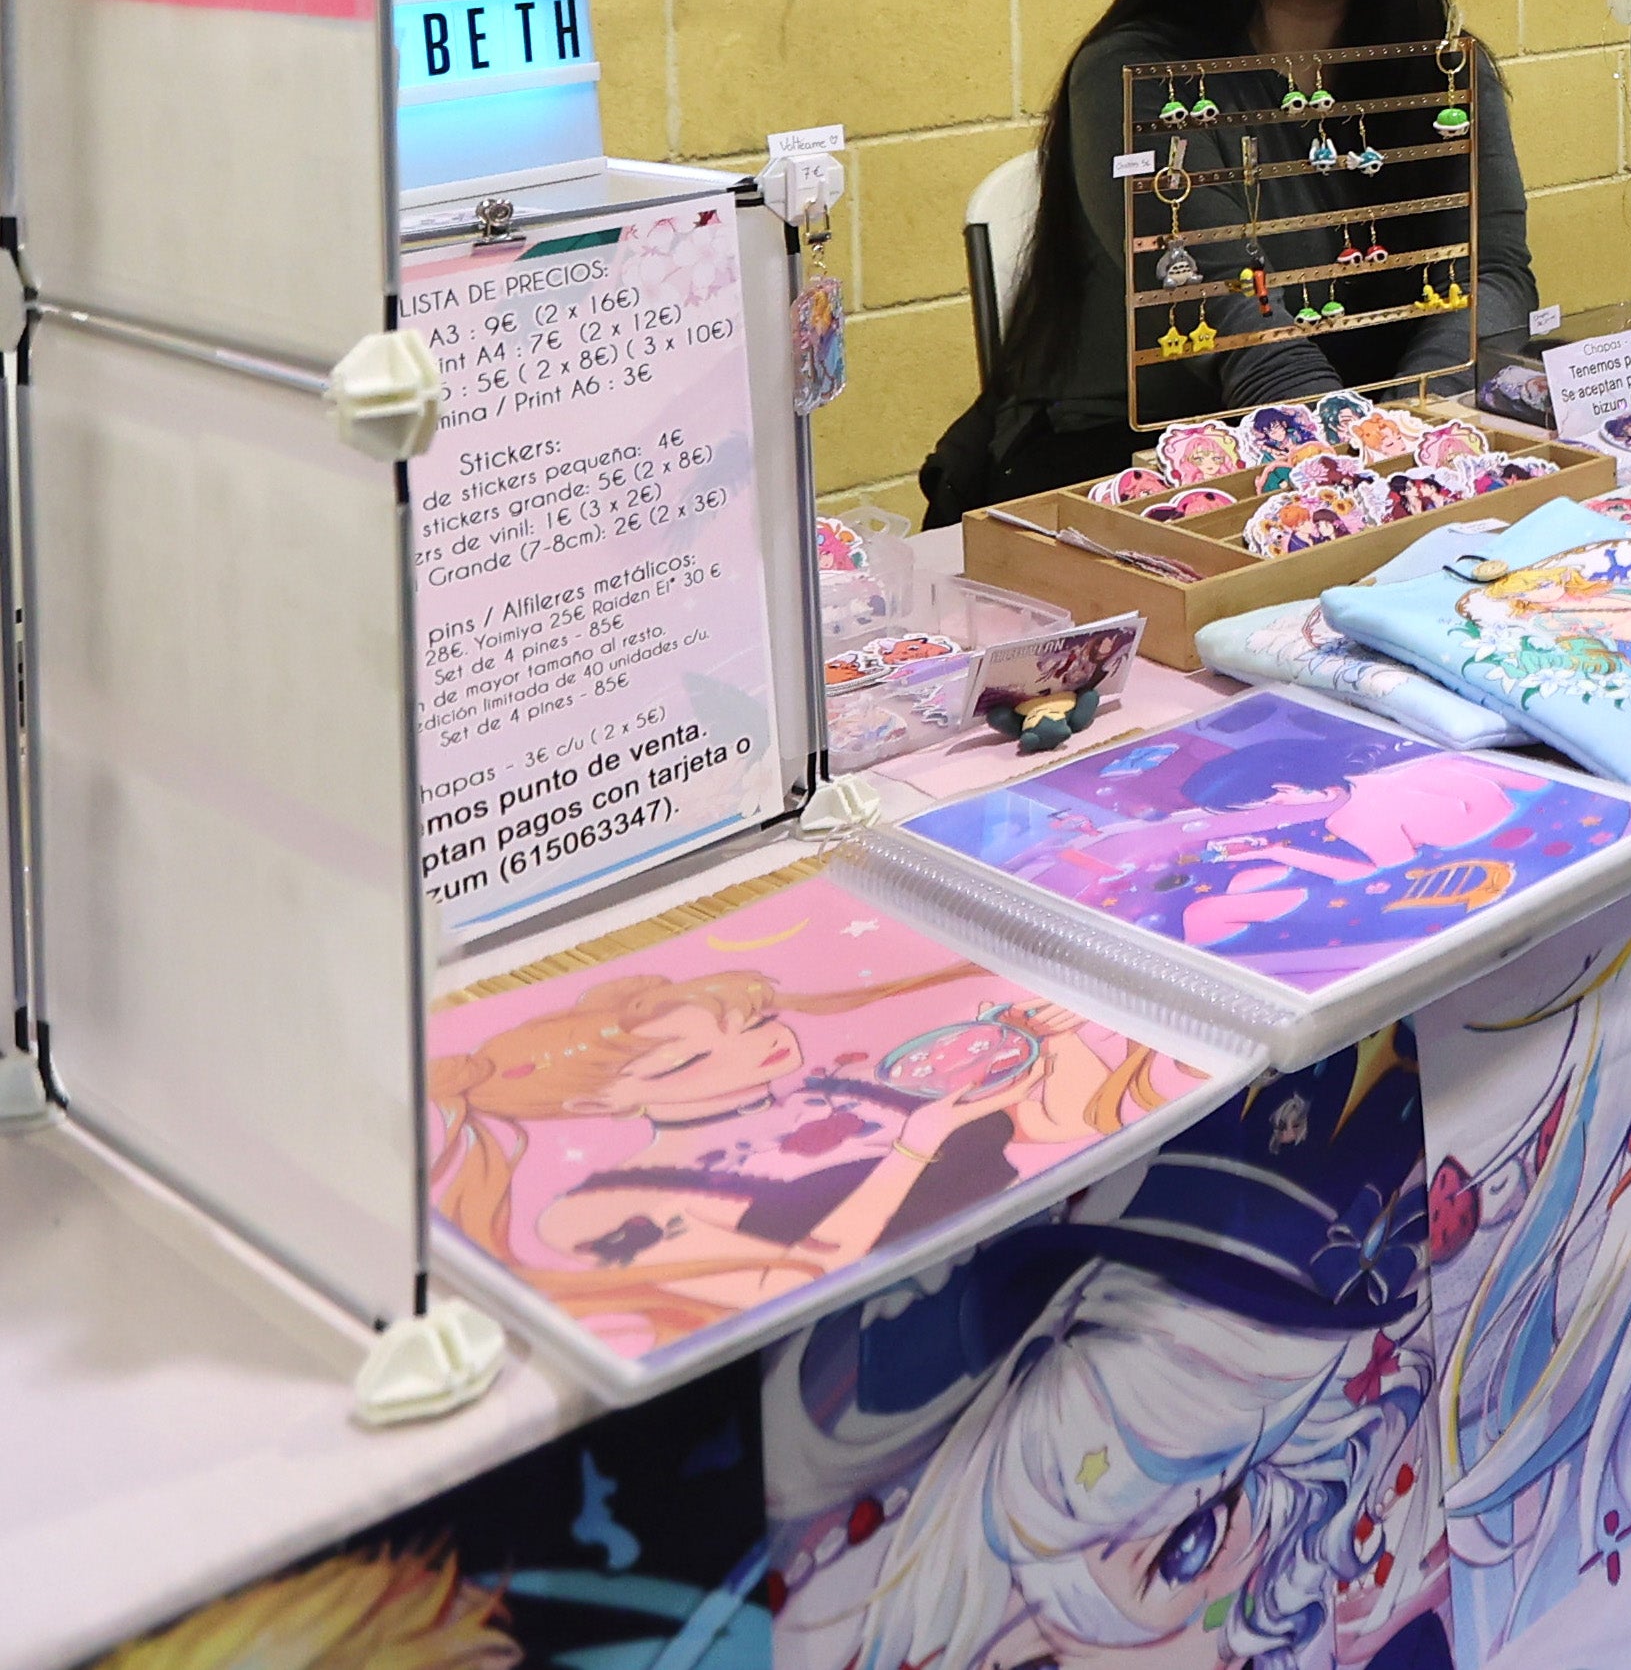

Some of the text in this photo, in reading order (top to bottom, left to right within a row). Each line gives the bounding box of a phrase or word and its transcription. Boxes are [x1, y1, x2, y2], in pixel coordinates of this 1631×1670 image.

[400, 260, 609, 318] LISTA DE PRECIOS:
[429, 325, 459, 348] A3
[485, 313, 517, 336] 9€
[535, 304, 557, 326] (2
[568, 306, 577, 319] x
[592, 288, 640, 314] 16€)
[439, 353, 465, 374] int
[477, 343, 505, 366] A4
[530, 331, 561, 354] 7€
[580, 322, 602, 343] (2
[612, 324, 620, 336] x
[635, 304, 681, 331] 12€)
[477, 369, 509, 393] 5€
[537, 360, 550, 380] 2
[561, 361, 570, 374] x
[579, 345, 618, 370] 8€)
[644, 337, 656, 355] 3
[666, 338, 674, 351] x
[688, 319, 733, 345] 10€)
[1568, 356, 1621, 380] Tenemos
[1583, 341, 1621, 356] Chapas
[497, 397, 505, 417] /
[515, 387, 561, 412] Print
[572, 377, 599, 398] A6
[623, 363, 652, 386] 3€
[1561, 389, 1576, 403] Se
[1579, 377, 1623, 398] aceptan
[1592, 399, 1627, 416] bizum
[423, 429, 684, 511] de stickers pequeña: 4€
[423, 445, 712, 537] stickers grande: 5€ (2 x 8€)
[460, 440, 561, 476] Stickers:
[428, 552, 512, 586] Grande
[521, 524, 606, 562] (7-8cm):
[614, 513, 642, 536] 2€
[650, 505, 669, 526] (2
[678, 506, 686, 518] x
[694, 488, 726, 512] 3€)
[452, 535, 481, 555] de
[490, 519, 534, 544] vinil:
[548, 508, 572, 529] 1€
[580, 499, 600, 520] (3
[610, 501, 618, 512] x
[626, 483, 661, 508] 2€)
[425, 642, 468, 667] 28€.
[474, 622, 542, 650] Yoimiya
[550, 605, 586, 629] 25€
[593, 590, 650, 615] Raiden
[684, 569, 704, 587] 30
[710, 563, 721, 578] €
[429, 554, 696, 648] pins / Alfileres metálicos:
[434, 666, 462, 685] Set
[472, 658, 495, 673] de
[504, 648, 513, 662] 4
[523, 636, 568, 661] pines
[589, 614, 624, 638] 85€
[434, 691, 458, 708] de
[466, 672, 520, 698] mayor
[528, 649, 593, 677] tamaño
[600, 638, 615, 654] al
[622, 627, 666, 648] resto.
[484, 683, 548, 711] limitada
[556, 673, 576, 688] de
[583, 662, 603, 678] 40
[610, 640, 678, 671] unidades
[684, 629, 709, 646] c/u.
[440, 728, 468, 747] Set
[477, 718, 500, 735] de
[510, 709, 519, 722] 4
[528, 695, 573, 721] pines
[595, 672, 629, 696] 85€
[420, 767, 495, 804] hapas
[525, 748, 549, 768] 3€
[557, 738, 583, 756] c/u
[604, 725, 614, 741] 2
[623, 724, 629, 733] x
[636, 706, 665, 729] 5€)
[500, 769, 578, 815] punto
[588, 753, 620, 778] de
[630, 724, 707, 762] venta.
[422, 737, 750, 878] ptan pagos con tarjeta o
[427, 796, 679, 904] zum (615063347).
